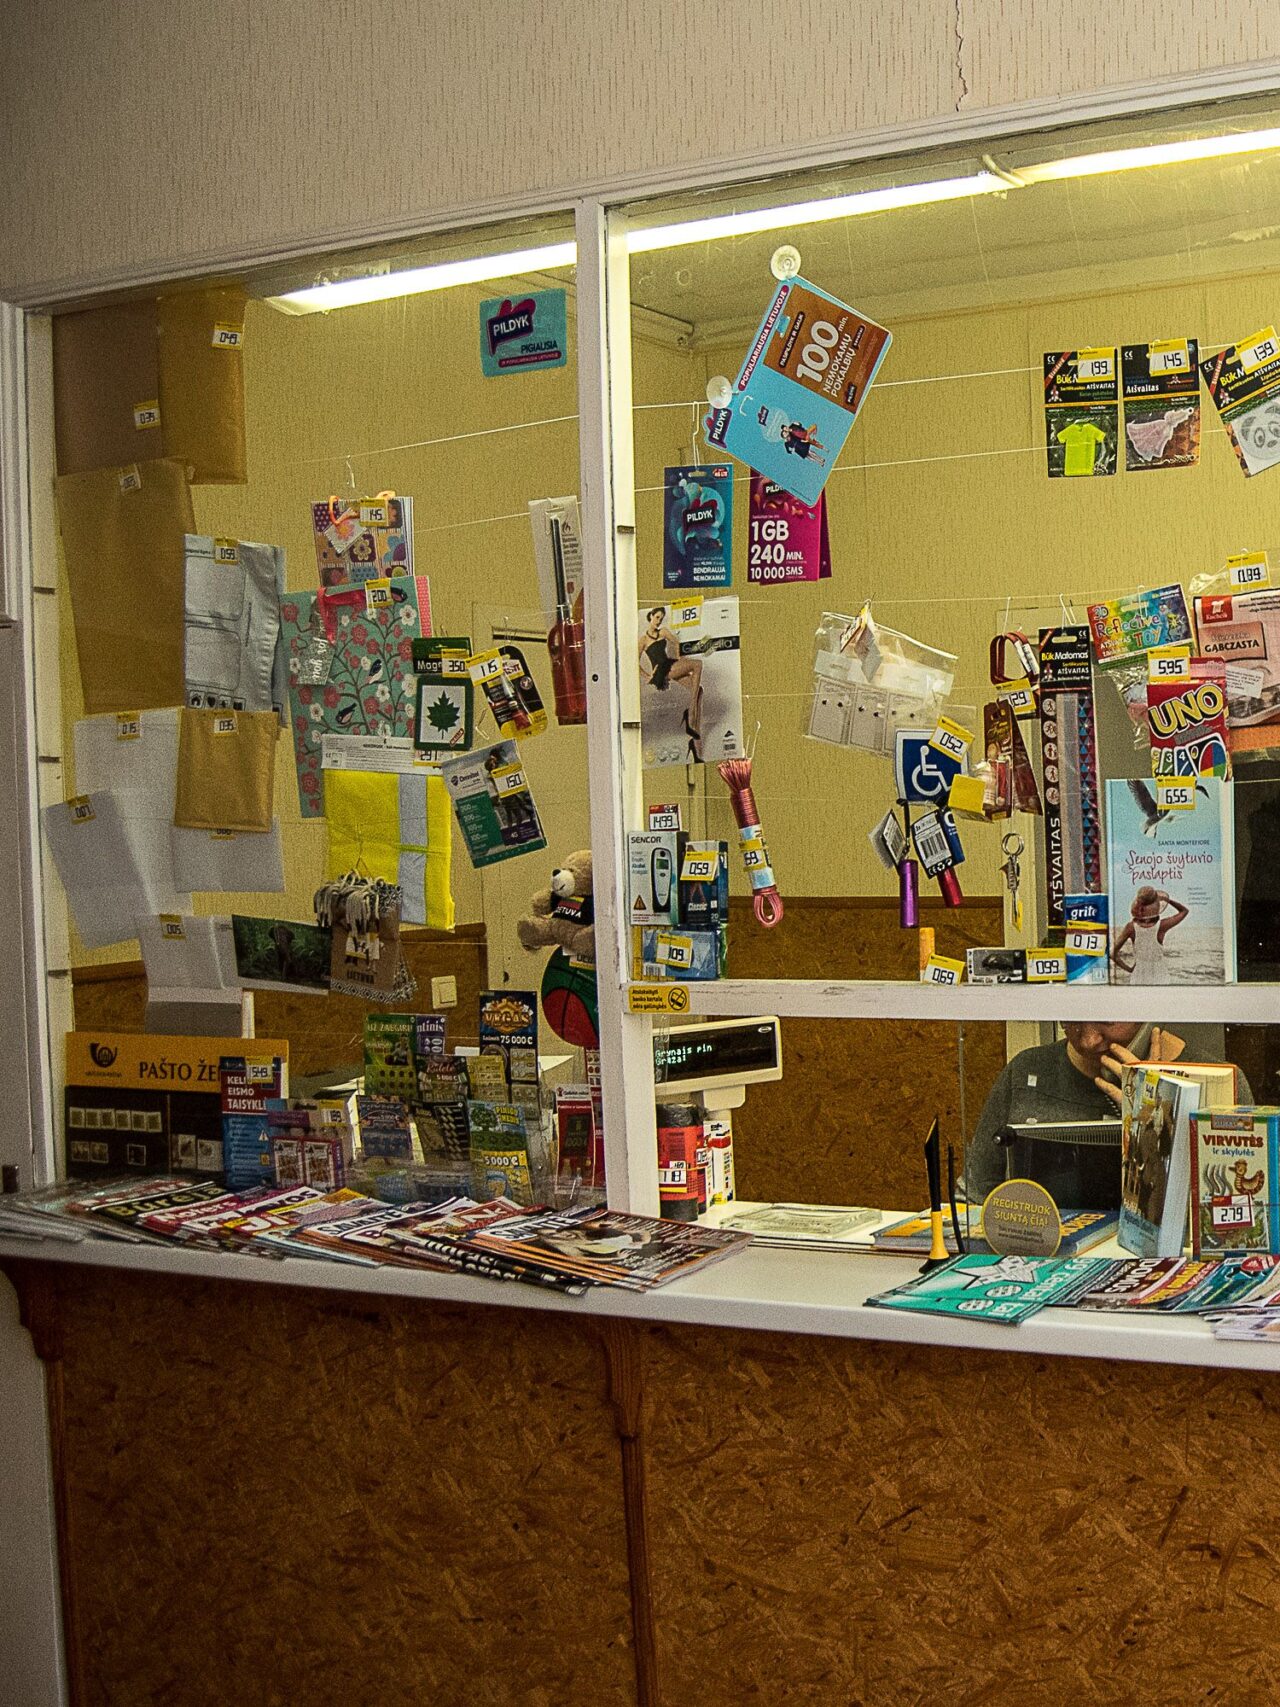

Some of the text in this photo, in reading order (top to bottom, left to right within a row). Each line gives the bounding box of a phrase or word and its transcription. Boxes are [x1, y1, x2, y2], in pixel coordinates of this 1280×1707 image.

[493, 314, 530, 337] PILDYK
[740, 290, 788, 387] POPULIARIAUSIA LIETUVOJE
[796, 320, 840, 383] 100
[822, 333, 854, 394] NEMOKAMŲ
[830, 347, 856, 398] POKALBIŲ
[1086, 382, 1115, 390] ATŠVAITAS
[1126, 383, 1160, 394] Atšvaitas
[712, 408, 729, 441] PILDYK
[686, 509, 714, 523] PILDYK
[750, 543, 785, 565] 240
[785, 566, 804, 576] SMS
[1094, 613, 1161, 637] Reflective
[1133, 627, 1162, 647] TOY
[1204, 639, 1260, 653] GĄBCZASTA
[1057, 666, 1089, 675] ATŠVAITAS
[1148, 684, 1224, 738] UNO
[630, 835, 662, 844] SENCOR
[1157, 838, 1211, 847] SANTA MONTEFIORE
[1051, 816, 1065, 912] ATŠVAITAS
[1124, 850, 1213, 869] Senojo švyturio
[1131, 867, 1183, 884] paslaptis
[655, 1046, 692, 1057] Grynais
[139, 1058, 220, 1082] PAŠTO ŽE
[227, 1088, 255, 1096] EISMO
[1202, 1133, 1265, 1149] VIRVUTĖS
[1212, 1146, 1256, 1158] ir skylutės
[993, 1196, 1051, 1216] REGISTRUOK
[994, 1210, 1029, 1226] SIUNTĄ
